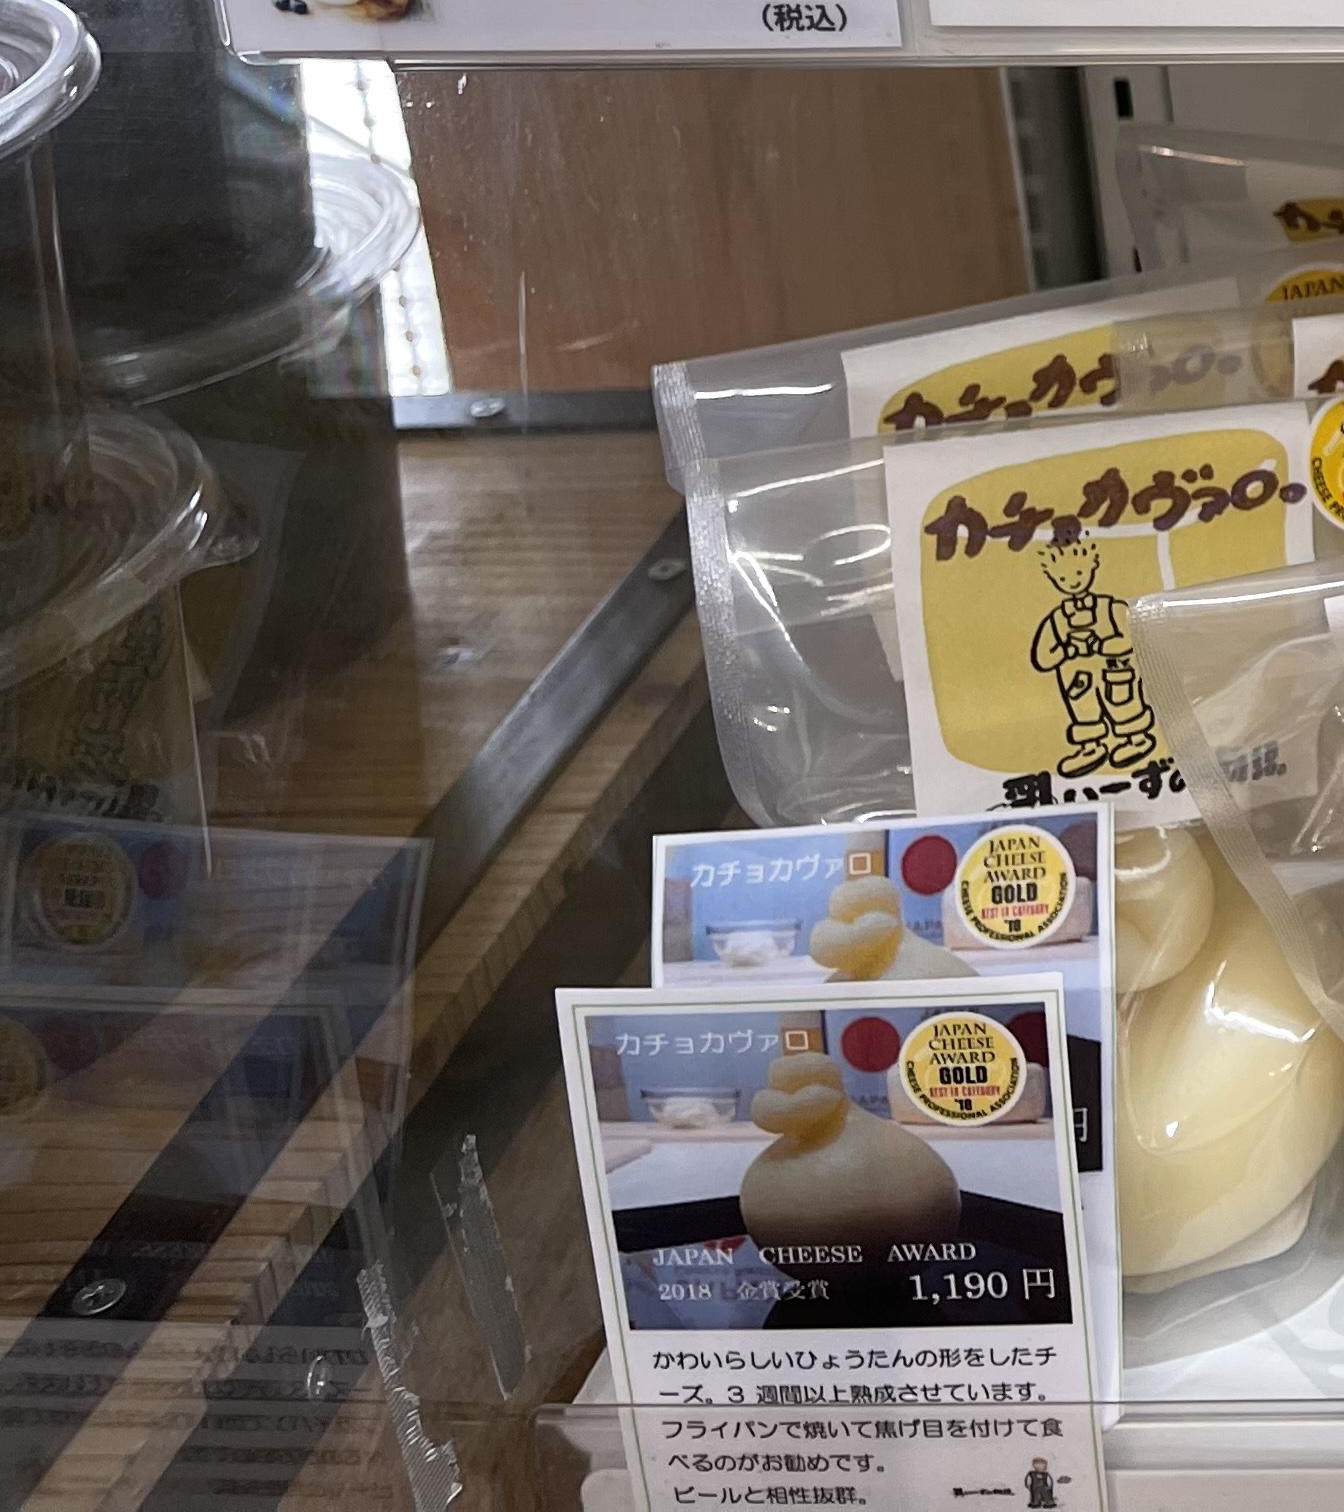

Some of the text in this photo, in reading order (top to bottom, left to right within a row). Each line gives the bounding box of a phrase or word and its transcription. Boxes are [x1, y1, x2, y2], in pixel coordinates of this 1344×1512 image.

[989, 837, 1040, 855] JAPAN
[691, 851, 873, 887] カチョカヴァロ
[983, 851, 1046, 868] CHEESE
[984, 867, 1046, 883] AWARD
[991, 882, 1038, 904] GOLD
[934, 1023, 987, 1037] JAPAN
[616, 1029, 809, 1056] カチョカヴァロ
[928, 1037, 995, 1050] CHEESE
[929, 1050, 996, 1065] AWARD
[939, 1066, 988, 1085] GOLD
[652, 1244, 977, 1268] JAPAN CHEESE AWARD
[658, 1268, 1057, 1306] 2018 金賞受賞 1,190 円
[652, 1347, 1057, 1371] かわいらしいひょうたんの形をしたチ
[661, 1419, 1063, 1440] フライパンで焼いて焦げ目を付けて食
[669, 1453, 886, 1473] べるのがお勧めです。
[674, 1486, 868, 1506] ビールと相性抜群。
